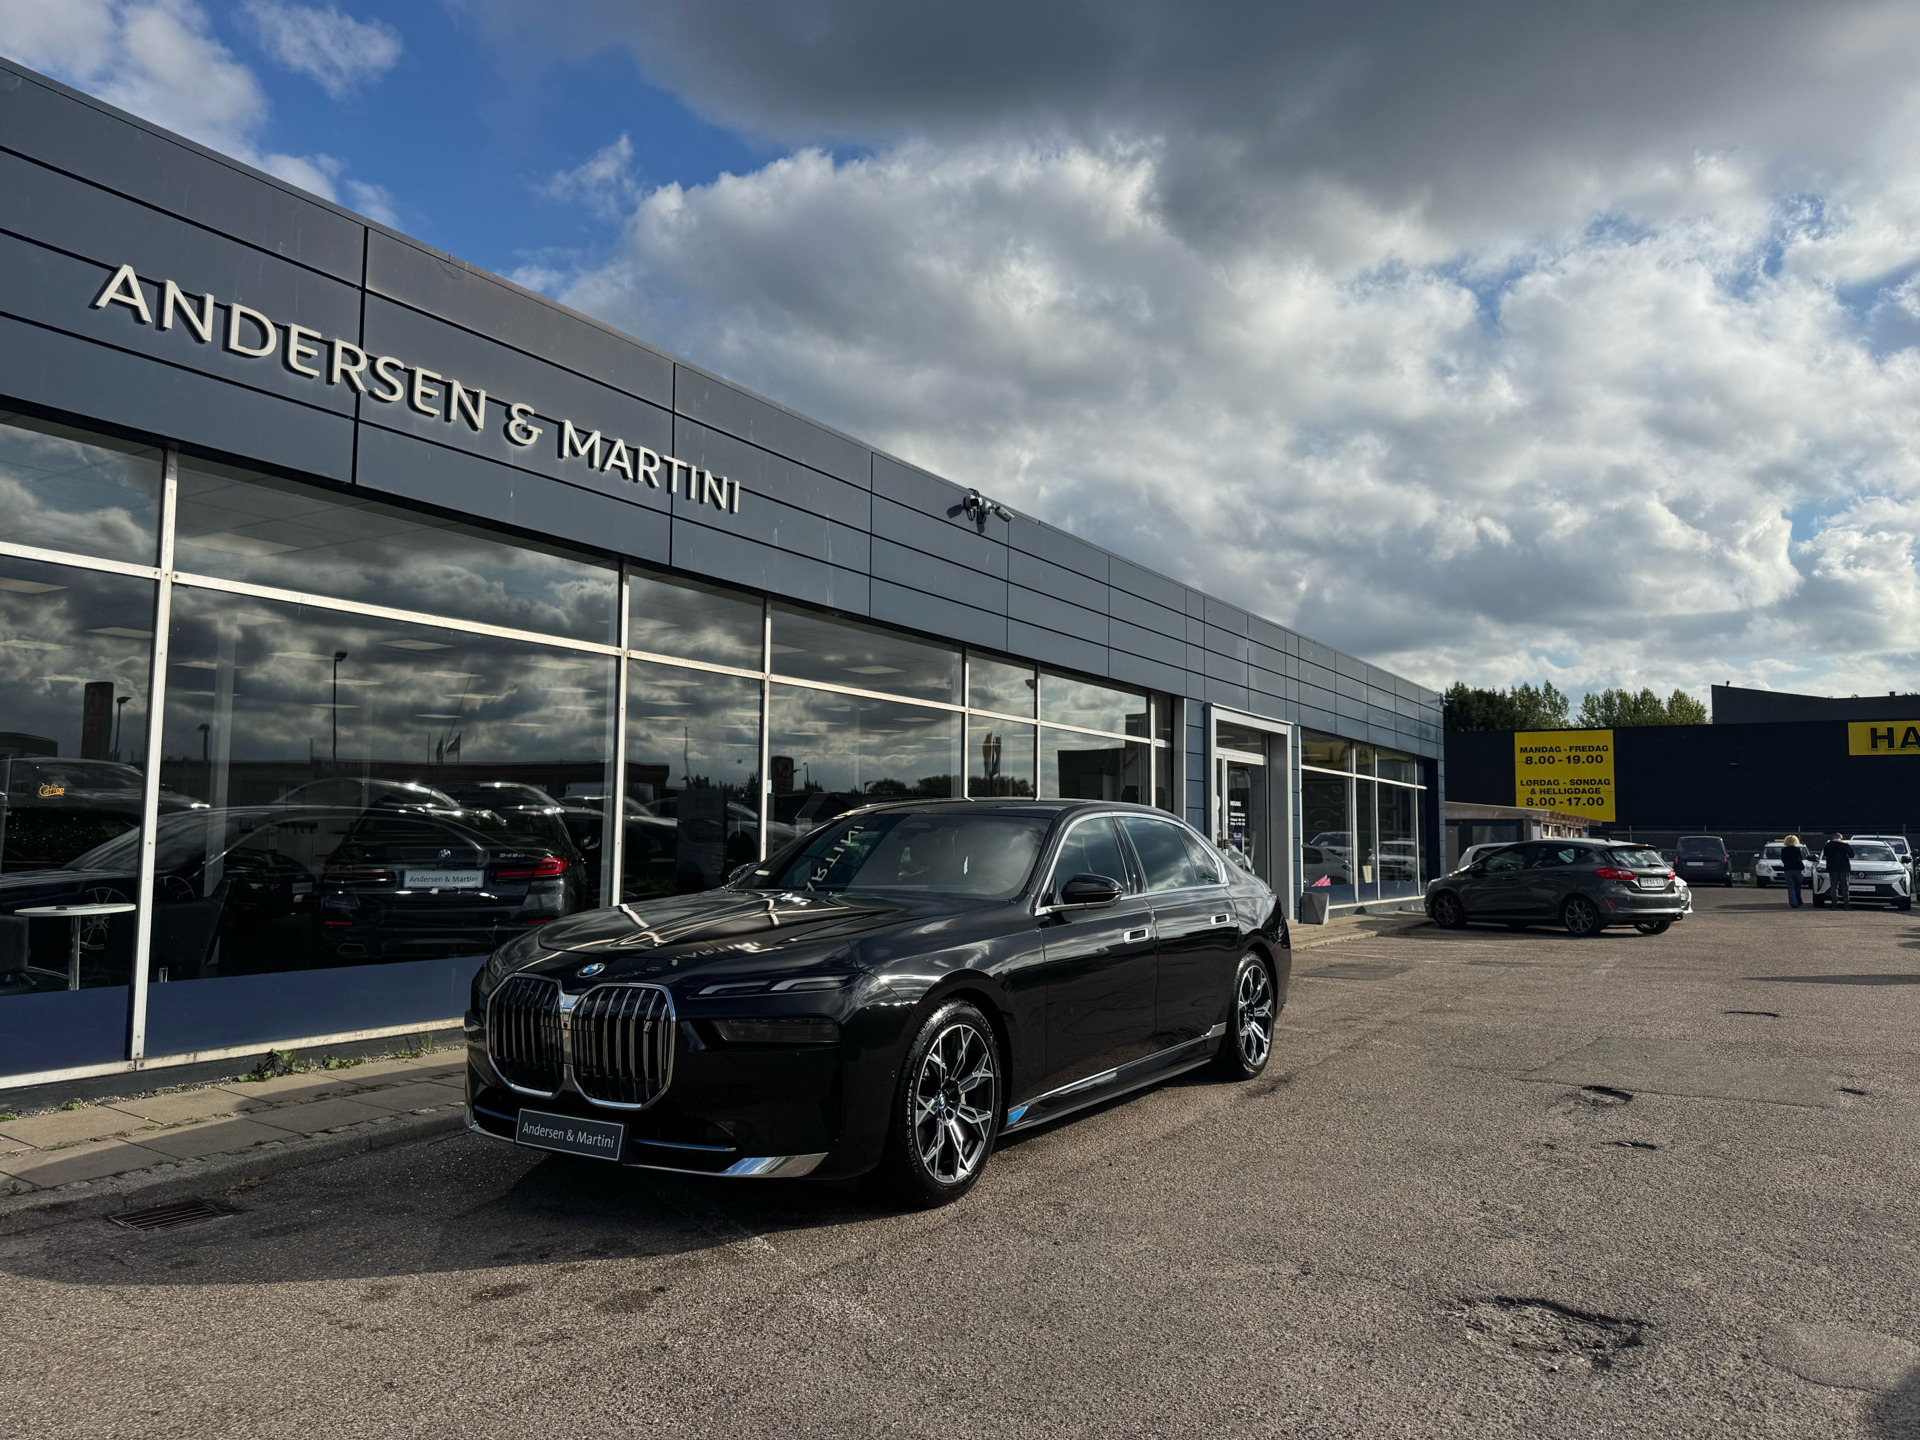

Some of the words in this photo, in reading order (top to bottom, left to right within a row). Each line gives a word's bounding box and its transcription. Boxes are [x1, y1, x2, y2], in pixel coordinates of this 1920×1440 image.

[95, 264, 486, 431] ANDERSEN
[508, 403, 543, 445] &
[562, 419, 740, 513] MARTINI
[1525, 756, 1555, 765] 8.00
[1566, 755, 1604, 764] 19.00
[39, 784, 65, 797] Coffee
[1526, 798, 1556, 807] 8.00
[1567, 797, 1604, 806] 17.00
[409, 875, 443, 883] Andersen
[444, 875, 451, 883] &
[452, 875, 479, 883] Martini
[522, 1122, 564, 1140] Andersen
[566, 1129, 575, 1142] &
[576, 1130, 615, 1148] Martini
